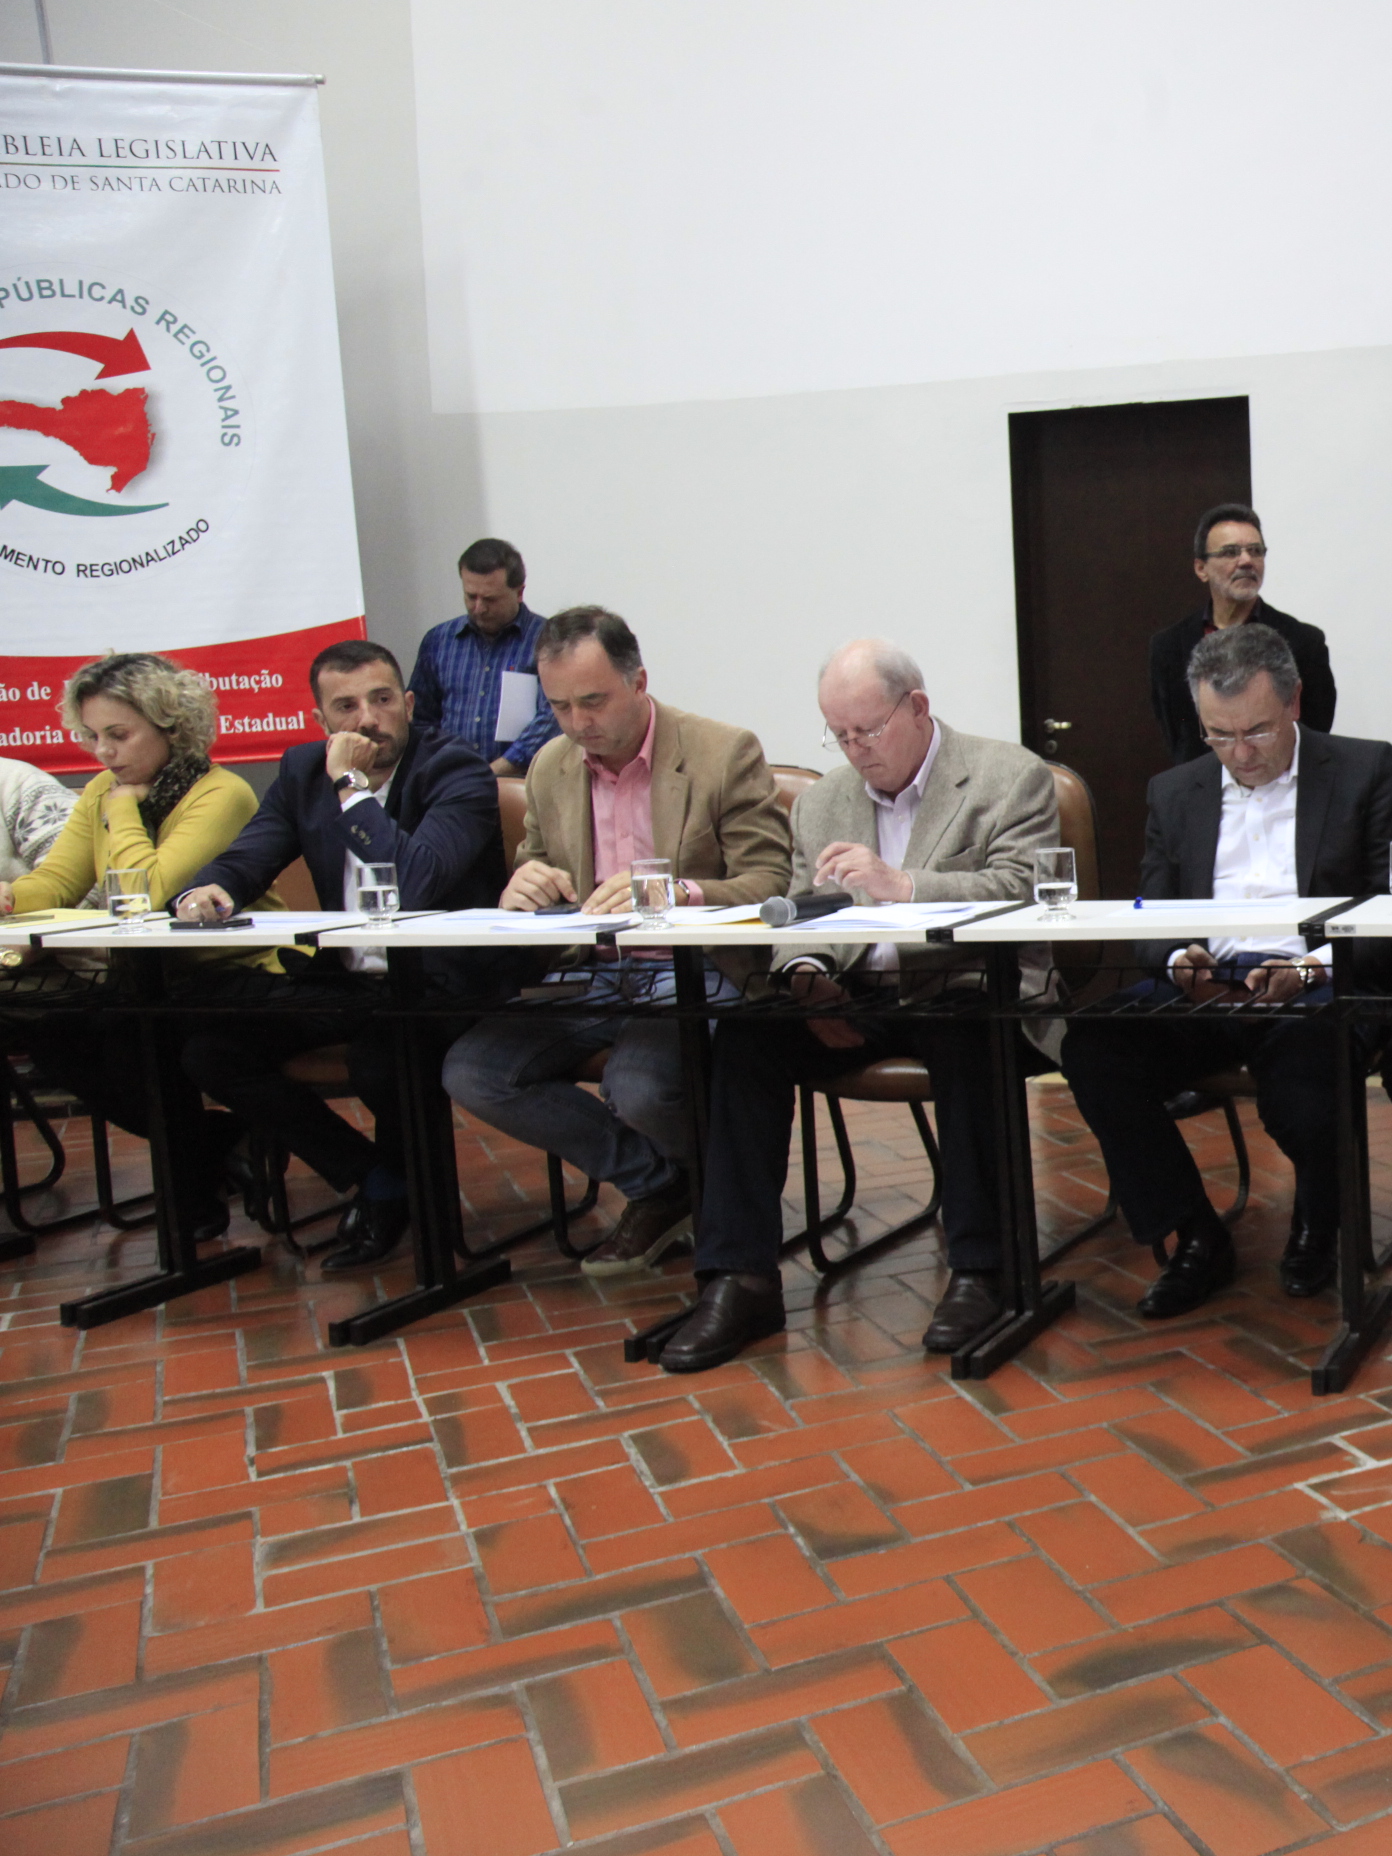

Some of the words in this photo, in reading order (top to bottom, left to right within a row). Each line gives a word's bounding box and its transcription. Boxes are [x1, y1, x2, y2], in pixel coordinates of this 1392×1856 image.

[0, 134, 87, 157] BLEIA
[96, 137, 278, 162] LEGISLATIVA
[0, 172, 41, 190] DO
[51, 174, 81, 191] DE
[89, 175, 162, 192] SANTA
[169, 176, 282, 194] CATARINA
[0, 276, 150, 316] PÚBLICAS
[154, 309, 241, 447] REGIONAIS
[0, 544, 66, 576] MENTO
[76, 518, 210, 578] REGIONALIZADO
[26, 681, 52, 700] de
[219, 710, 305, 734] Estadual
